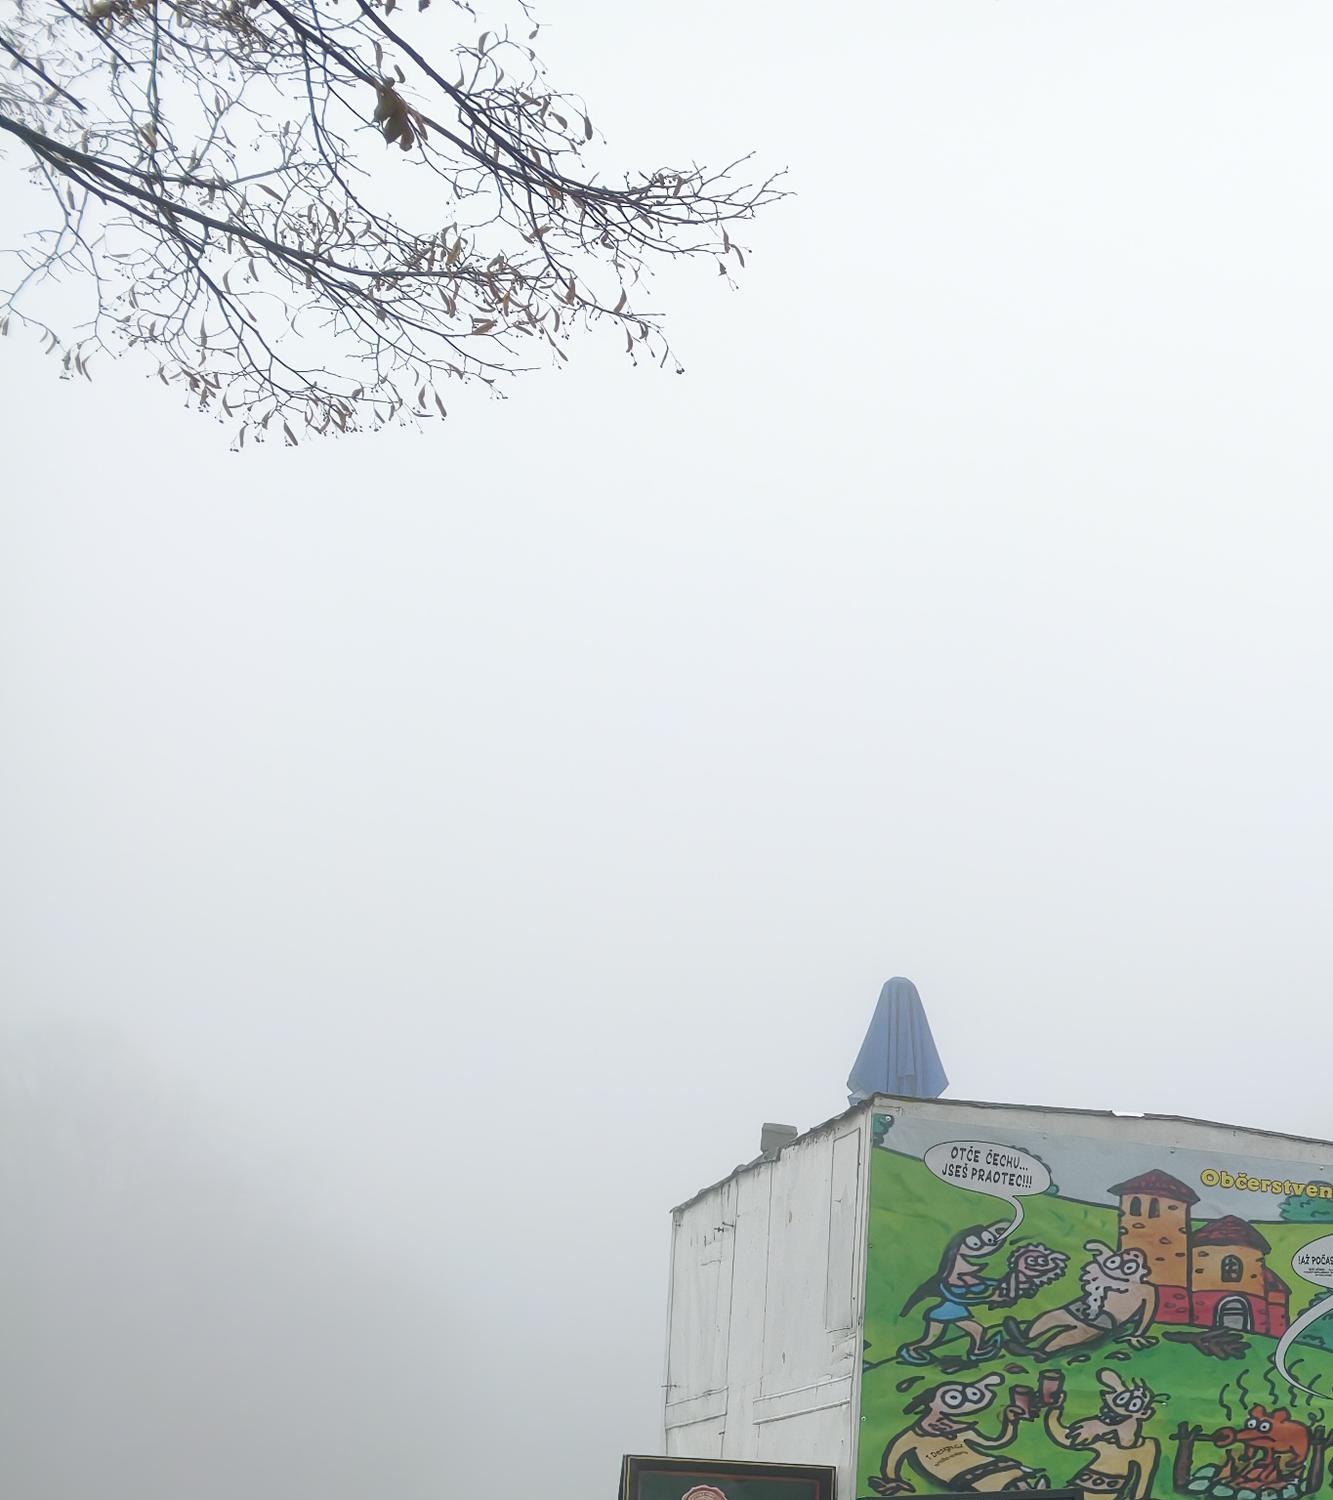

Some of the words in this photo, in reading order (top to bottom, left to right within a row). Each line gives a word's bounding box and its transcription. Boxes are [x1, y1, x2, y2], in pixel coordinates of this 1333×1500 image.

[951, 1146, 980, 1162] OTČE
[942, 1163, 968, 1178] JSEŠ
[971, 1168, 1032, 1188] PRAOTEC!!!
